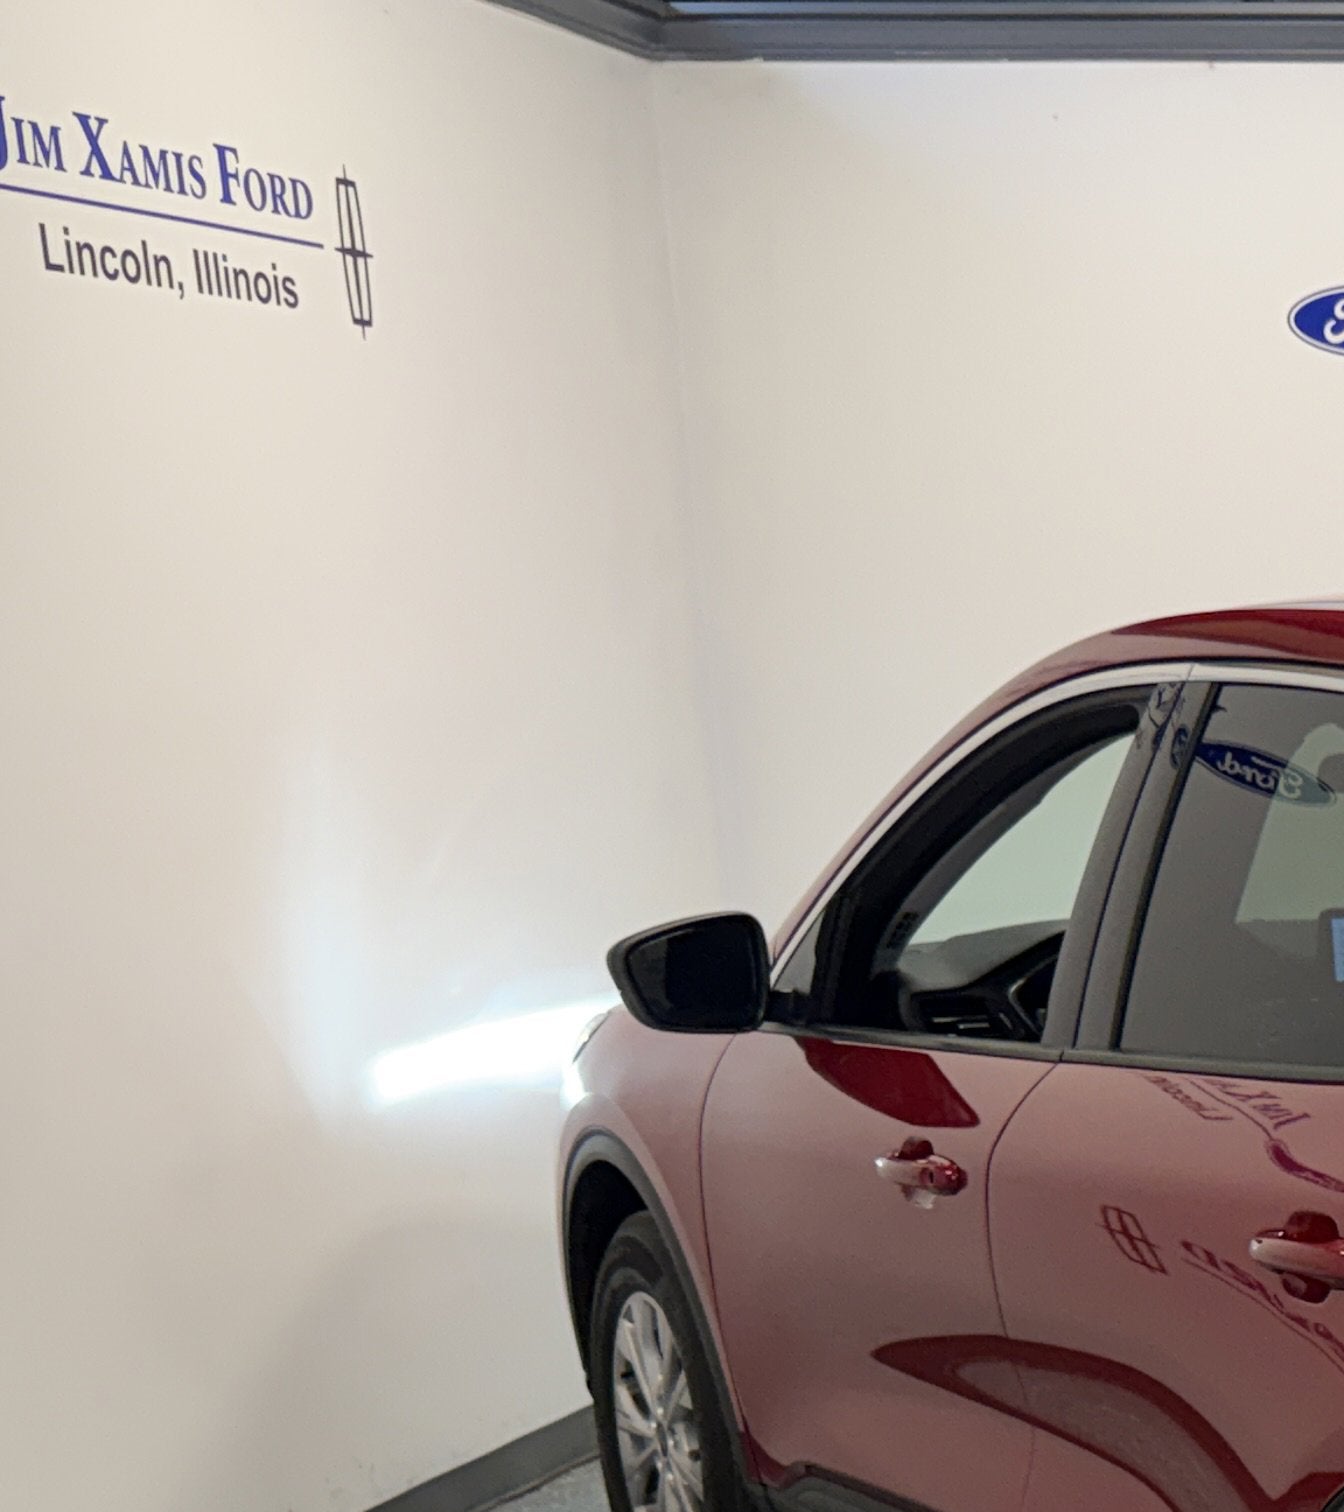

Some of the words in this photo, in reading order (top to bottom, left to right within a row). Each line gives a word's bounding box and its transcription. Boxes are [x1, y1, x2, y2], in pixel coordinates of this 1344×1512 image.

[72, 111, 207, 200] XAMIS
[213, 143, 313, 220] FORD
[39, 222, 185, 300] Lincoln,
[193, 249, 299, 309] Illinois
